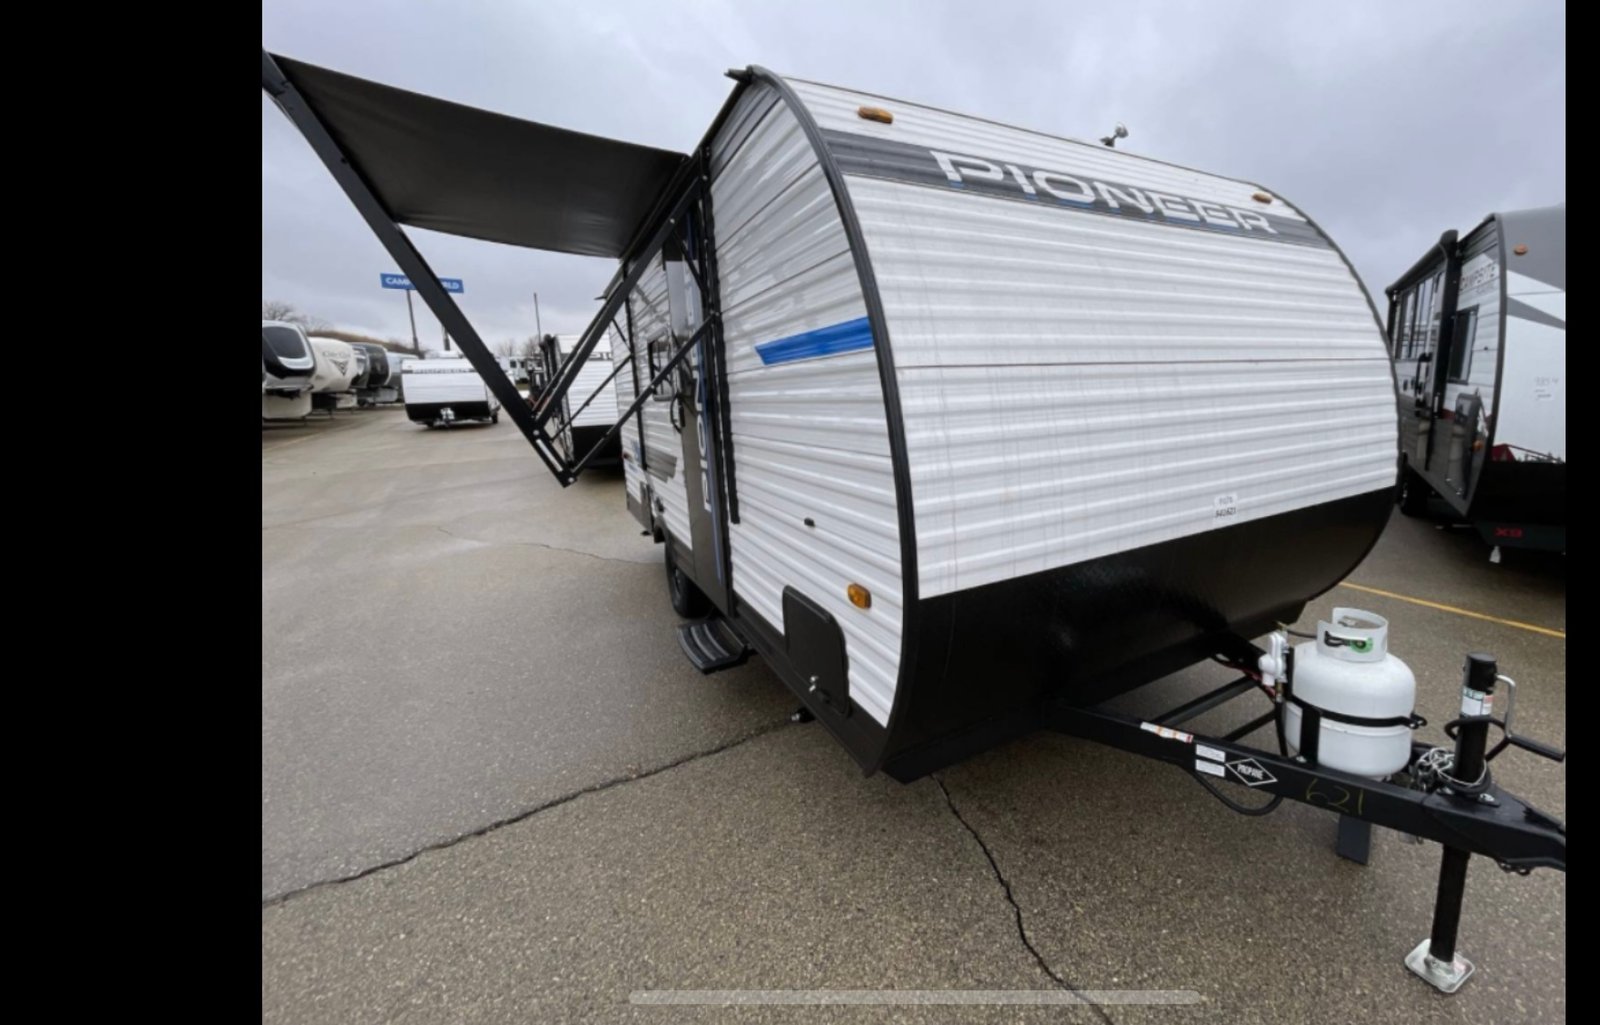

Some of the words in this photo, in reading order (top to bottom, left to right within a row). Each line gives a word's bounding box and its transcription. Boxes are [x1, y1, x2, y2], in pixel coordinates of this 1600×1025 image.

[930, 149, 1278, 234] PIONEER
[1237, 763, 1264, 780] PROPANE
[1306, 777, 1364, 816] 621
